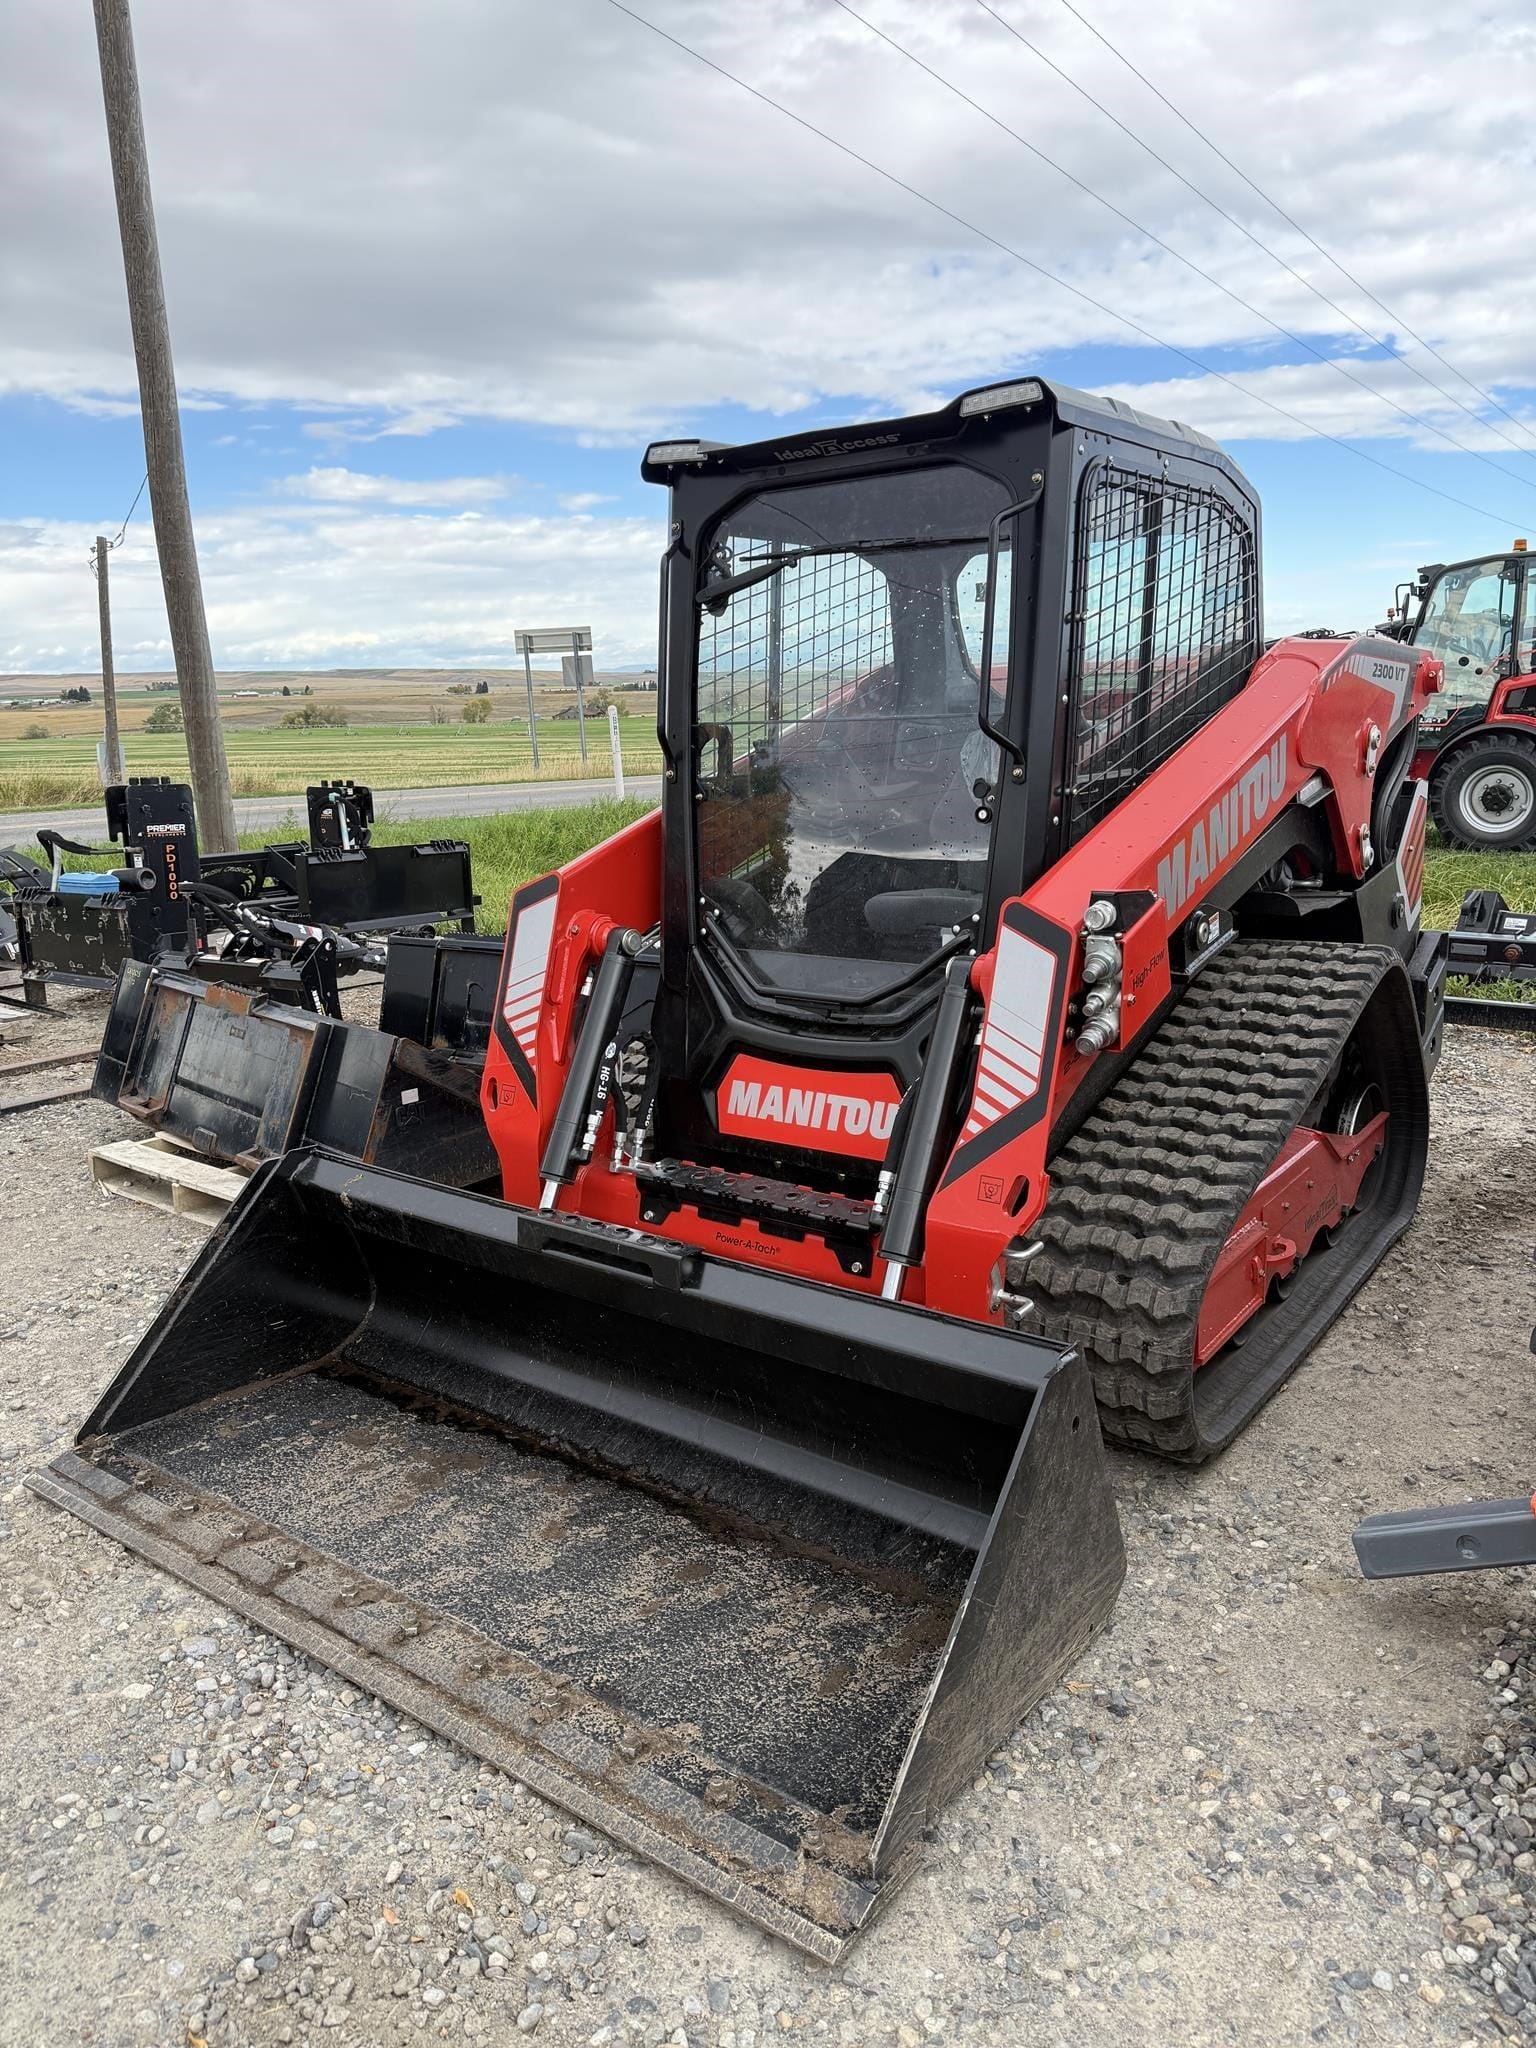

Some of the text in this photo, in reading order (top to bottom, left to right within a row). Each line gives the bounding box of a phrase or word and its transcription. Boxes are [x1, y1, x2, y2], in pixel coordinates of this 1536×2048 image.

[1372, 662, 1406, 682] 2300 VT
[146, 823, 186, 833] PREMIER
[1157, 732, 1287, 920] MANITOU
[165, 844, 179, 900] PD1000
[1132, 948, 1166, 991] High-Flow
[596, 1065, 611, 1100] HG-16
[727, 1079, 900, 1140] MANITOU
